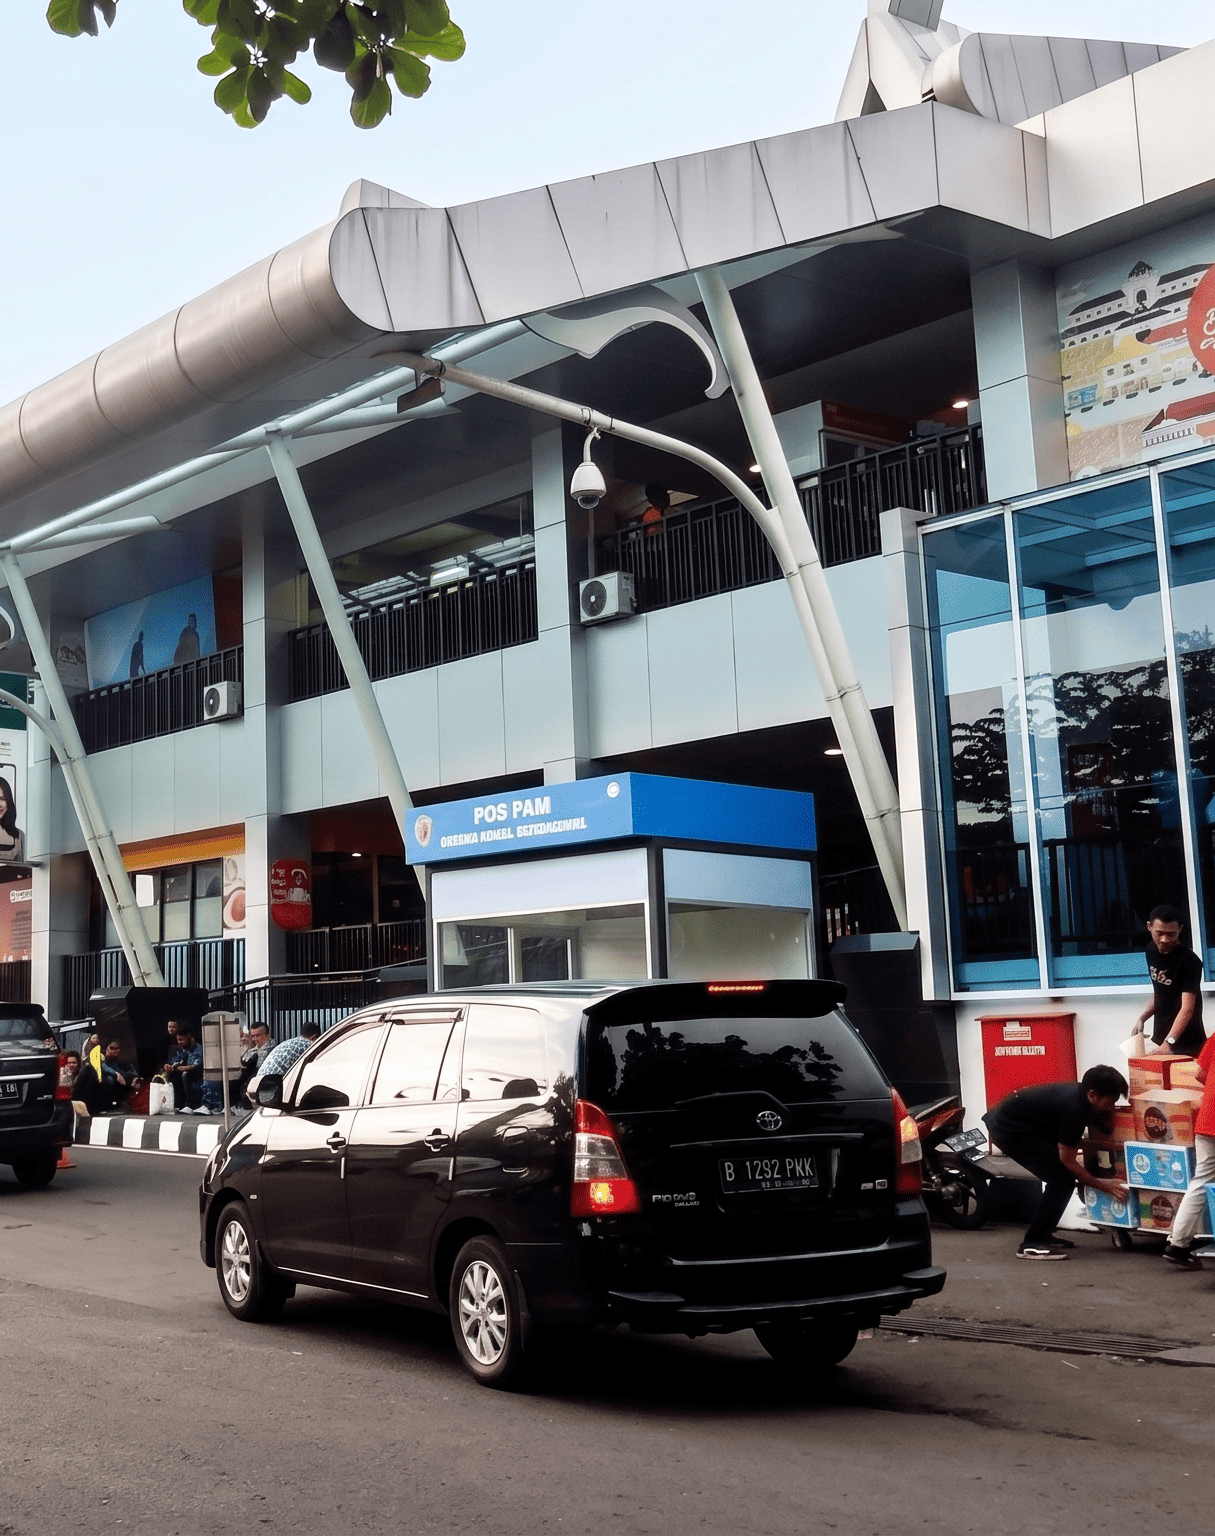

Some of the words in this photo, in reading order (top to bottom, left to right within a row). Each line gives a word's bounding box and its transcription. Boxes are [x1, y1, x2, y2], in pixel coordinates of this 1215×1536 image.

[473, 802, 508, 825] POS
[512, 796, 552, 819] PAM
[724, 1161, 735, 1182] B
[785, 1157, 814, 1178] PKK
